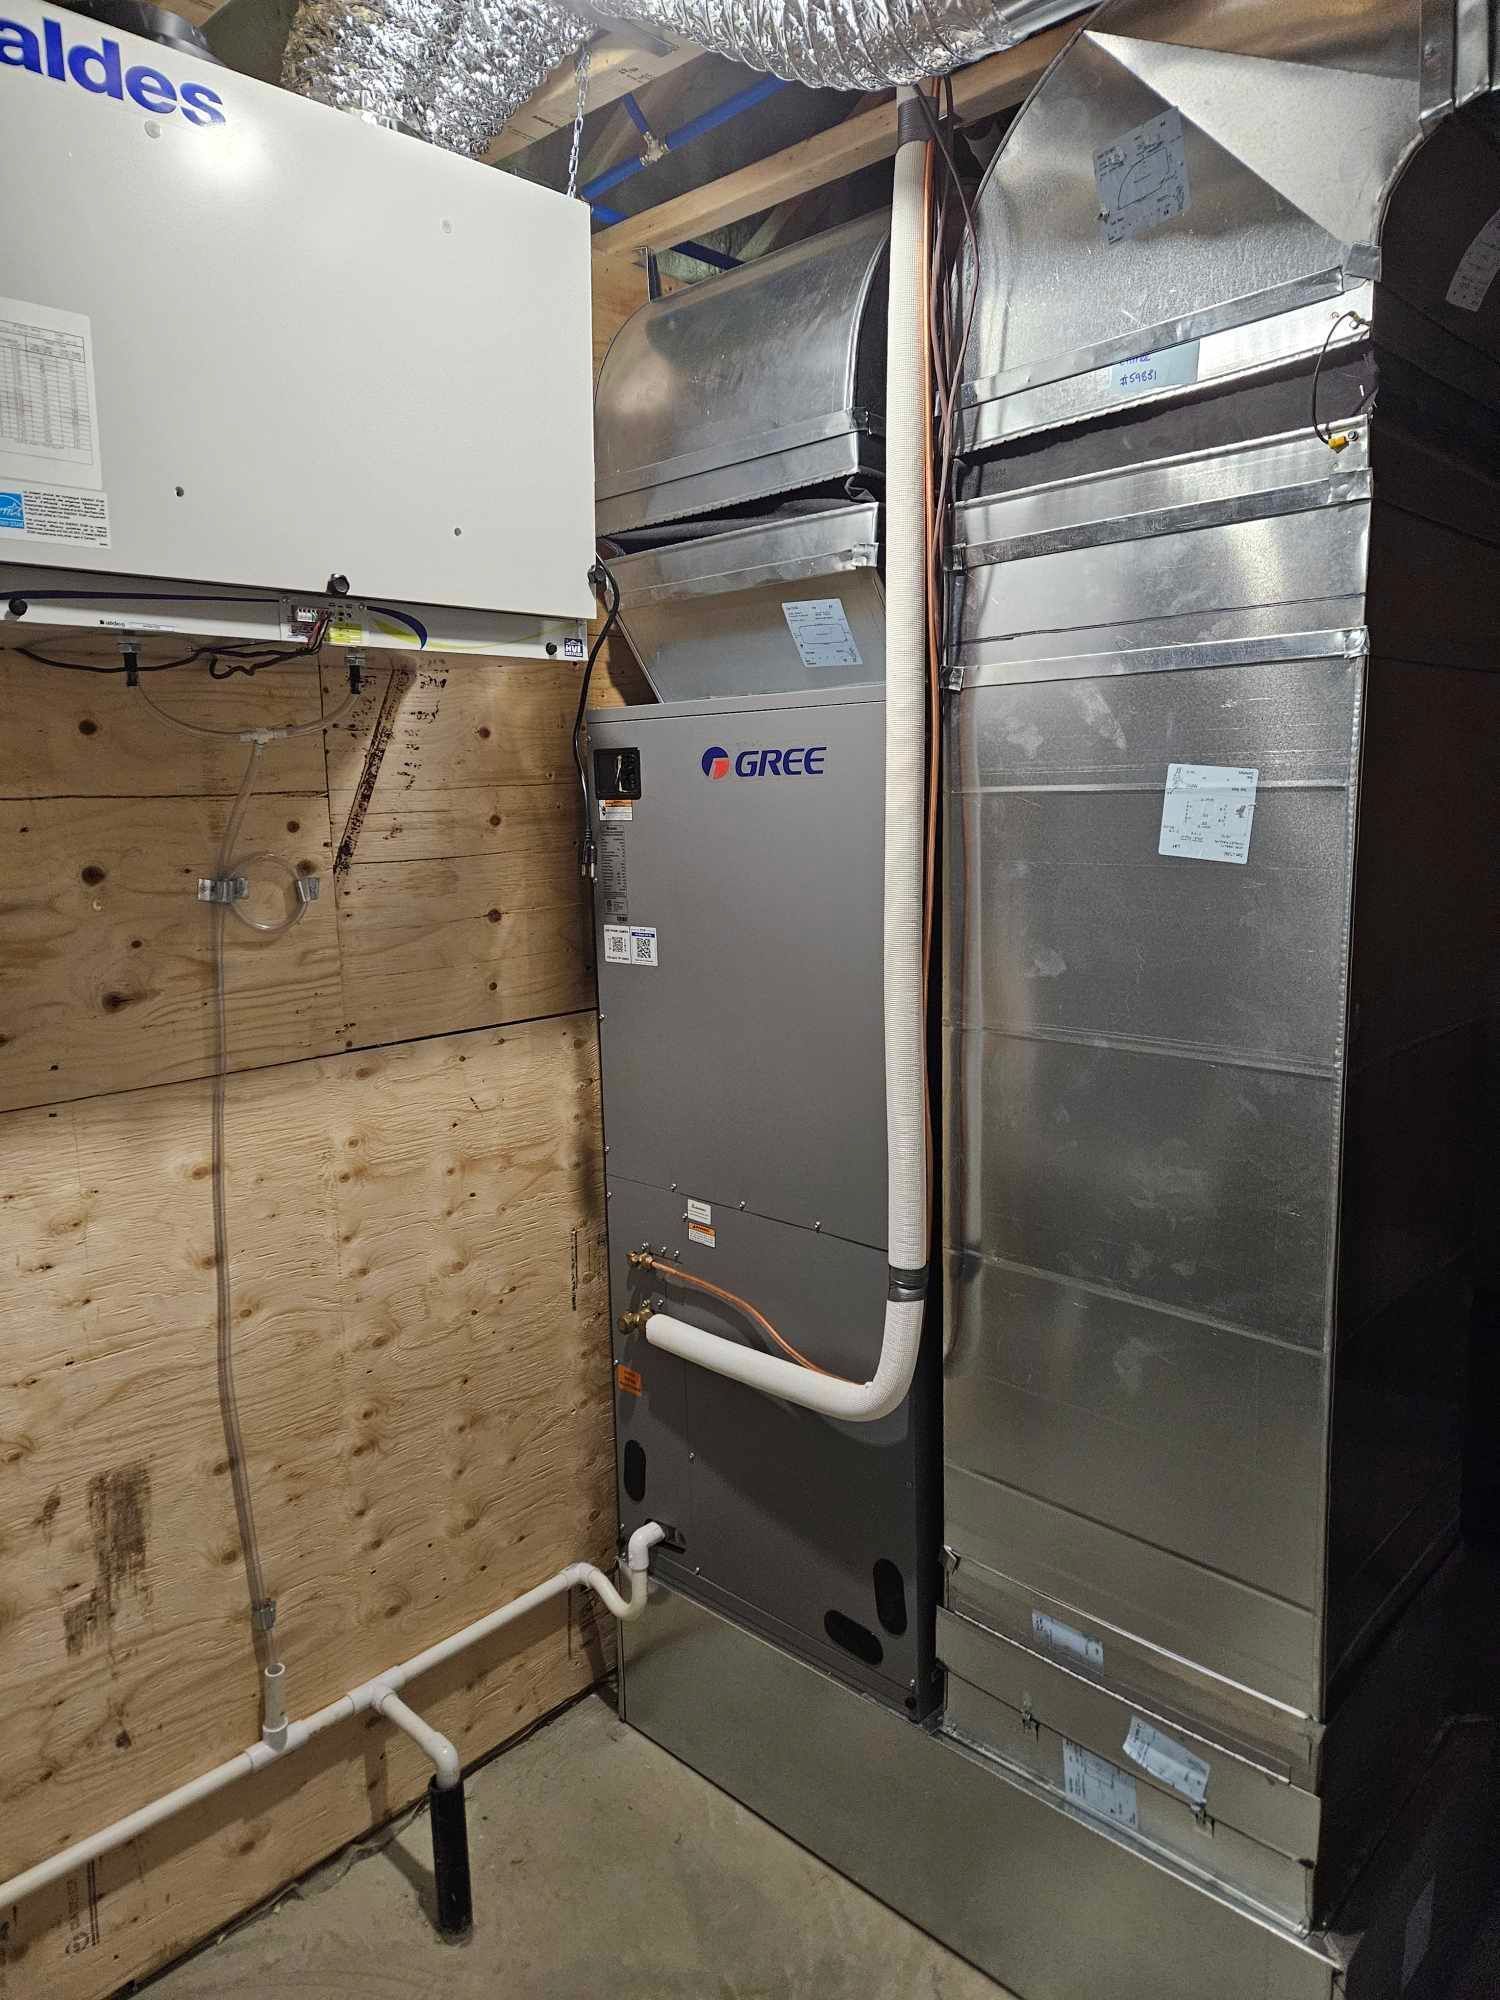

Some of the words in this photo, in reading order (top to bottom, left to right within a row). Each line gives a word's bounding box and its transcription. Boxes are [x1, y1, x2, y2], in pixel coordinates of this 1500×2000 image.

[0, 16, 226, 126] aldes
[565, 644, 581, 653] HVI
[735, 746, 827, 777] GREE
